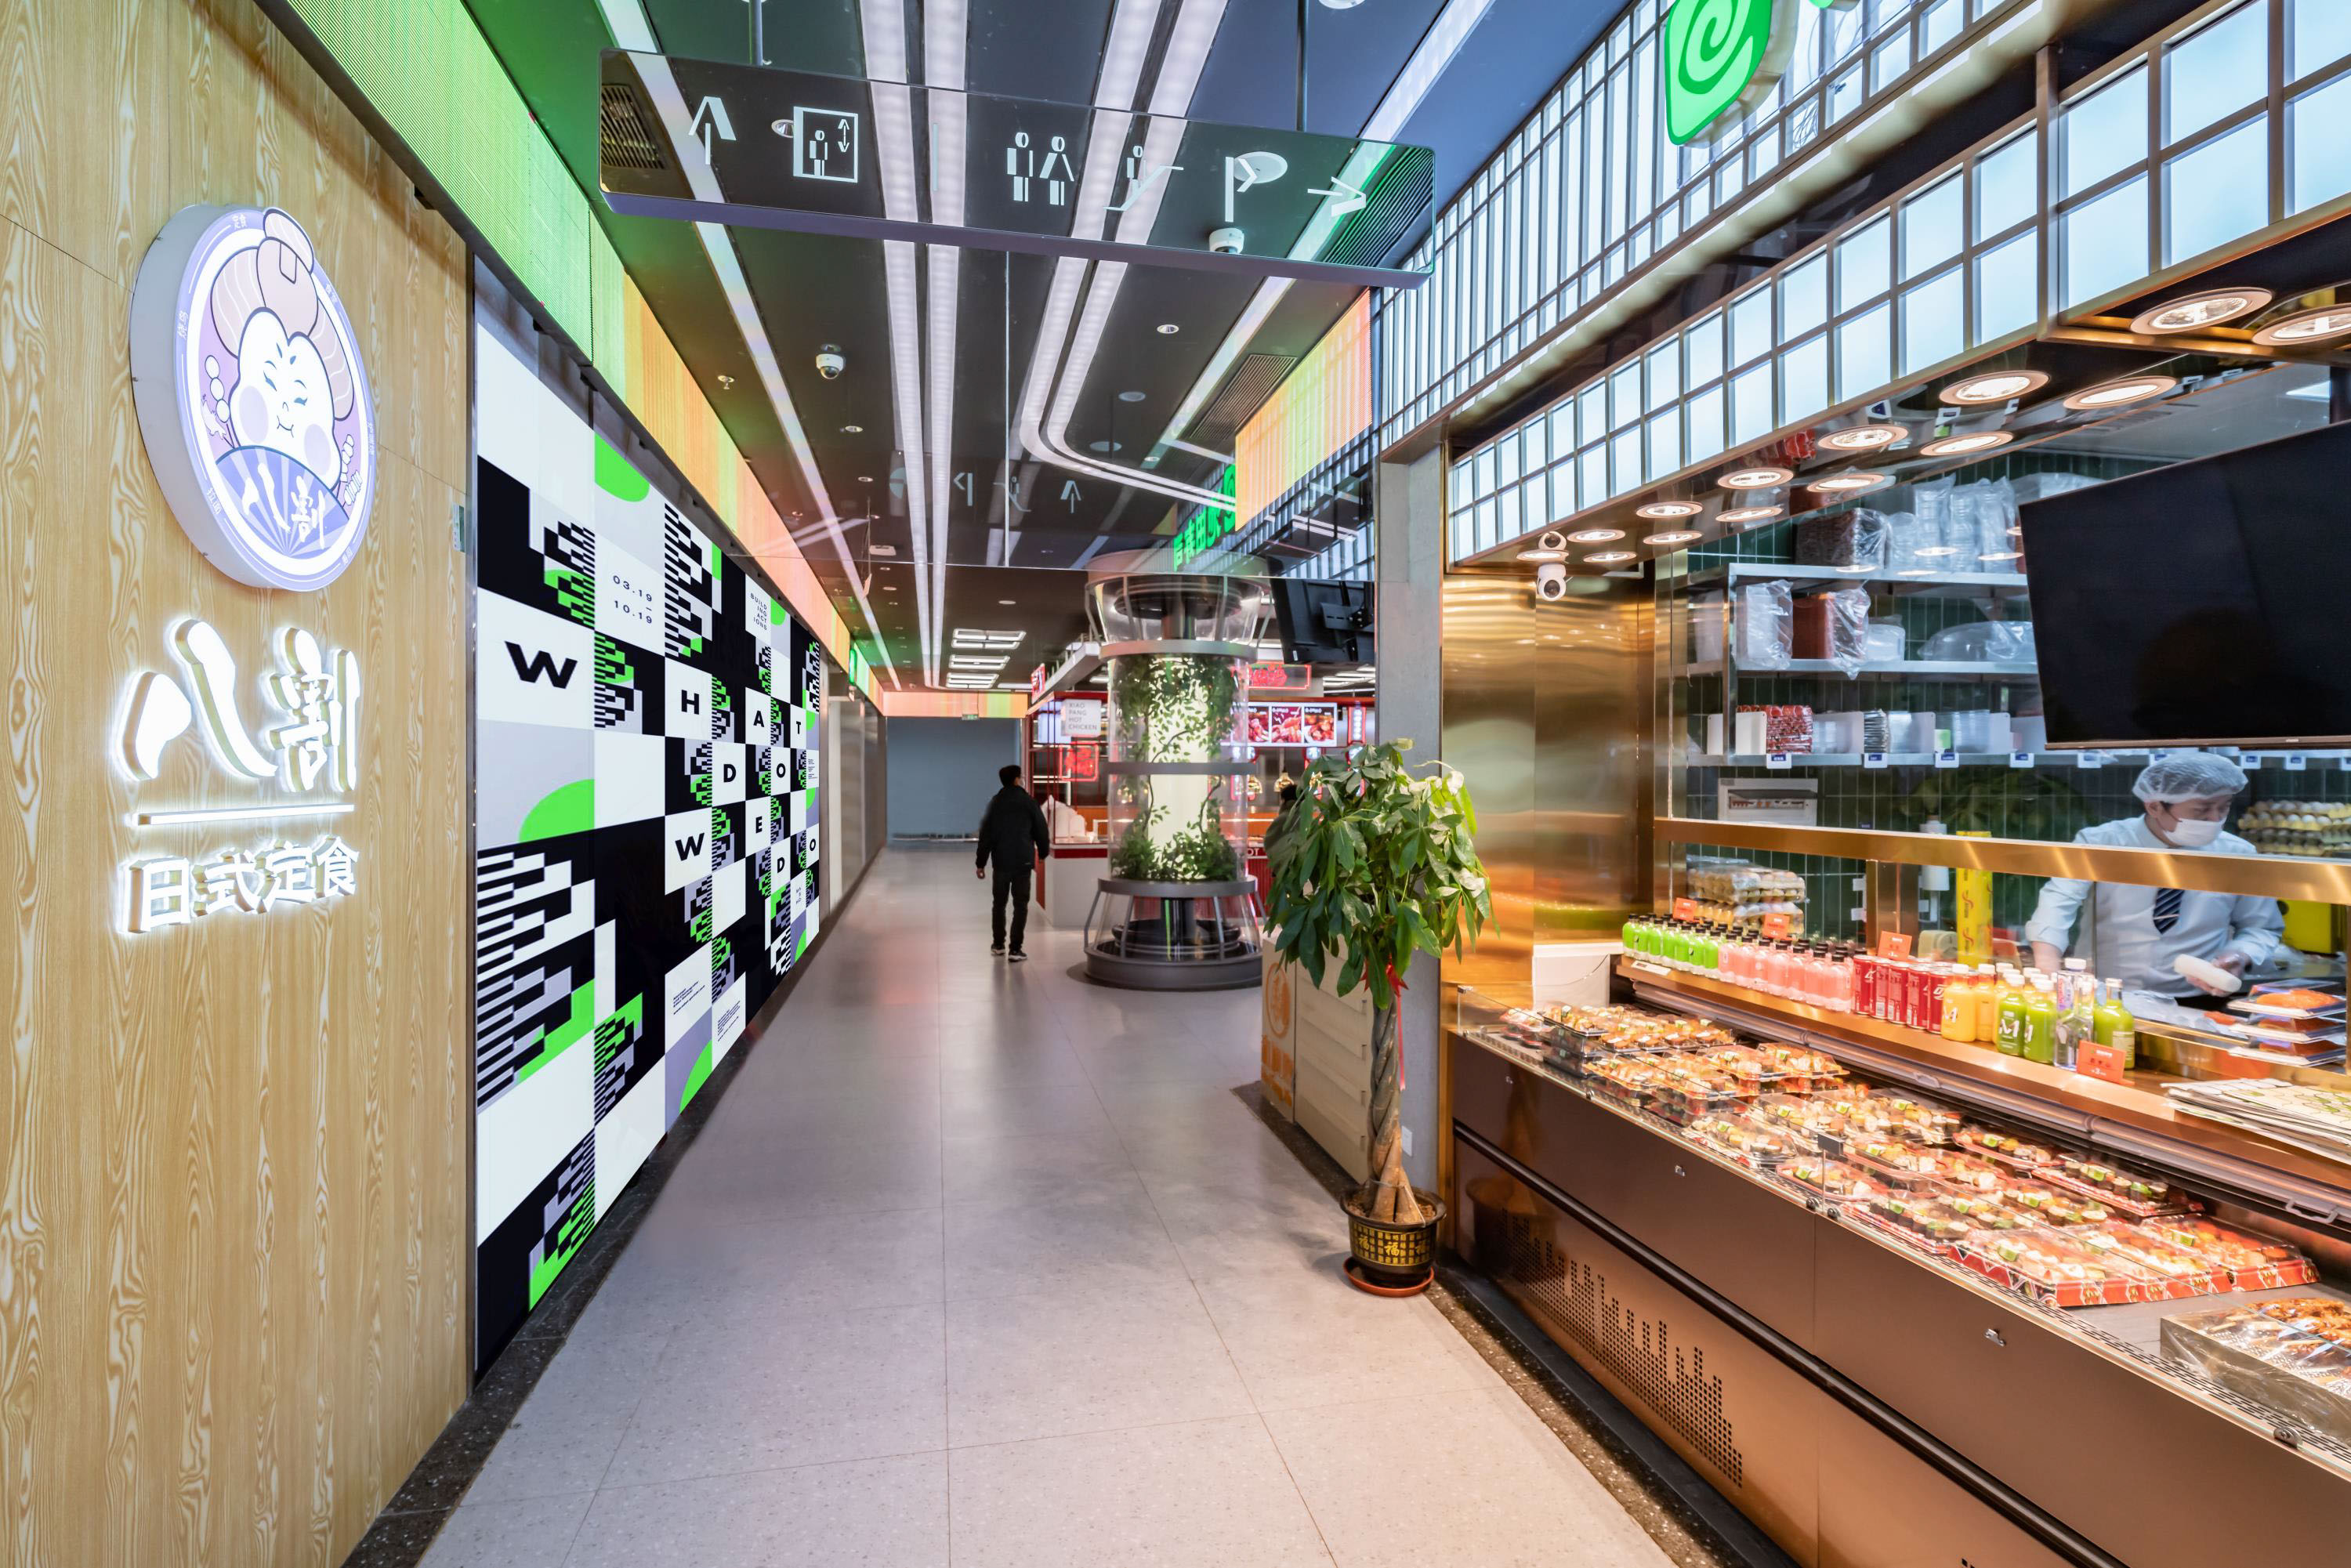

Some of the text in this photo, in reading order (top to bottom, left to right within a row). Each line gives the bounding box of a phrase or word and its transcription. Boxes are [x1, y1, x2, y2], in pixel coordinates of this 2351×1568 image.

[242, 463, 326, 549] 八割
[613, 575, 652, 602] 03.19
[750, 592, 767, 610] BUILD
[614, 600, 652, 624] 10.19
[123, 619, 360, 791] 八割
[125, 836, 358, 932] 日式定食
[1384, 1241, 1399, 1256] 福
